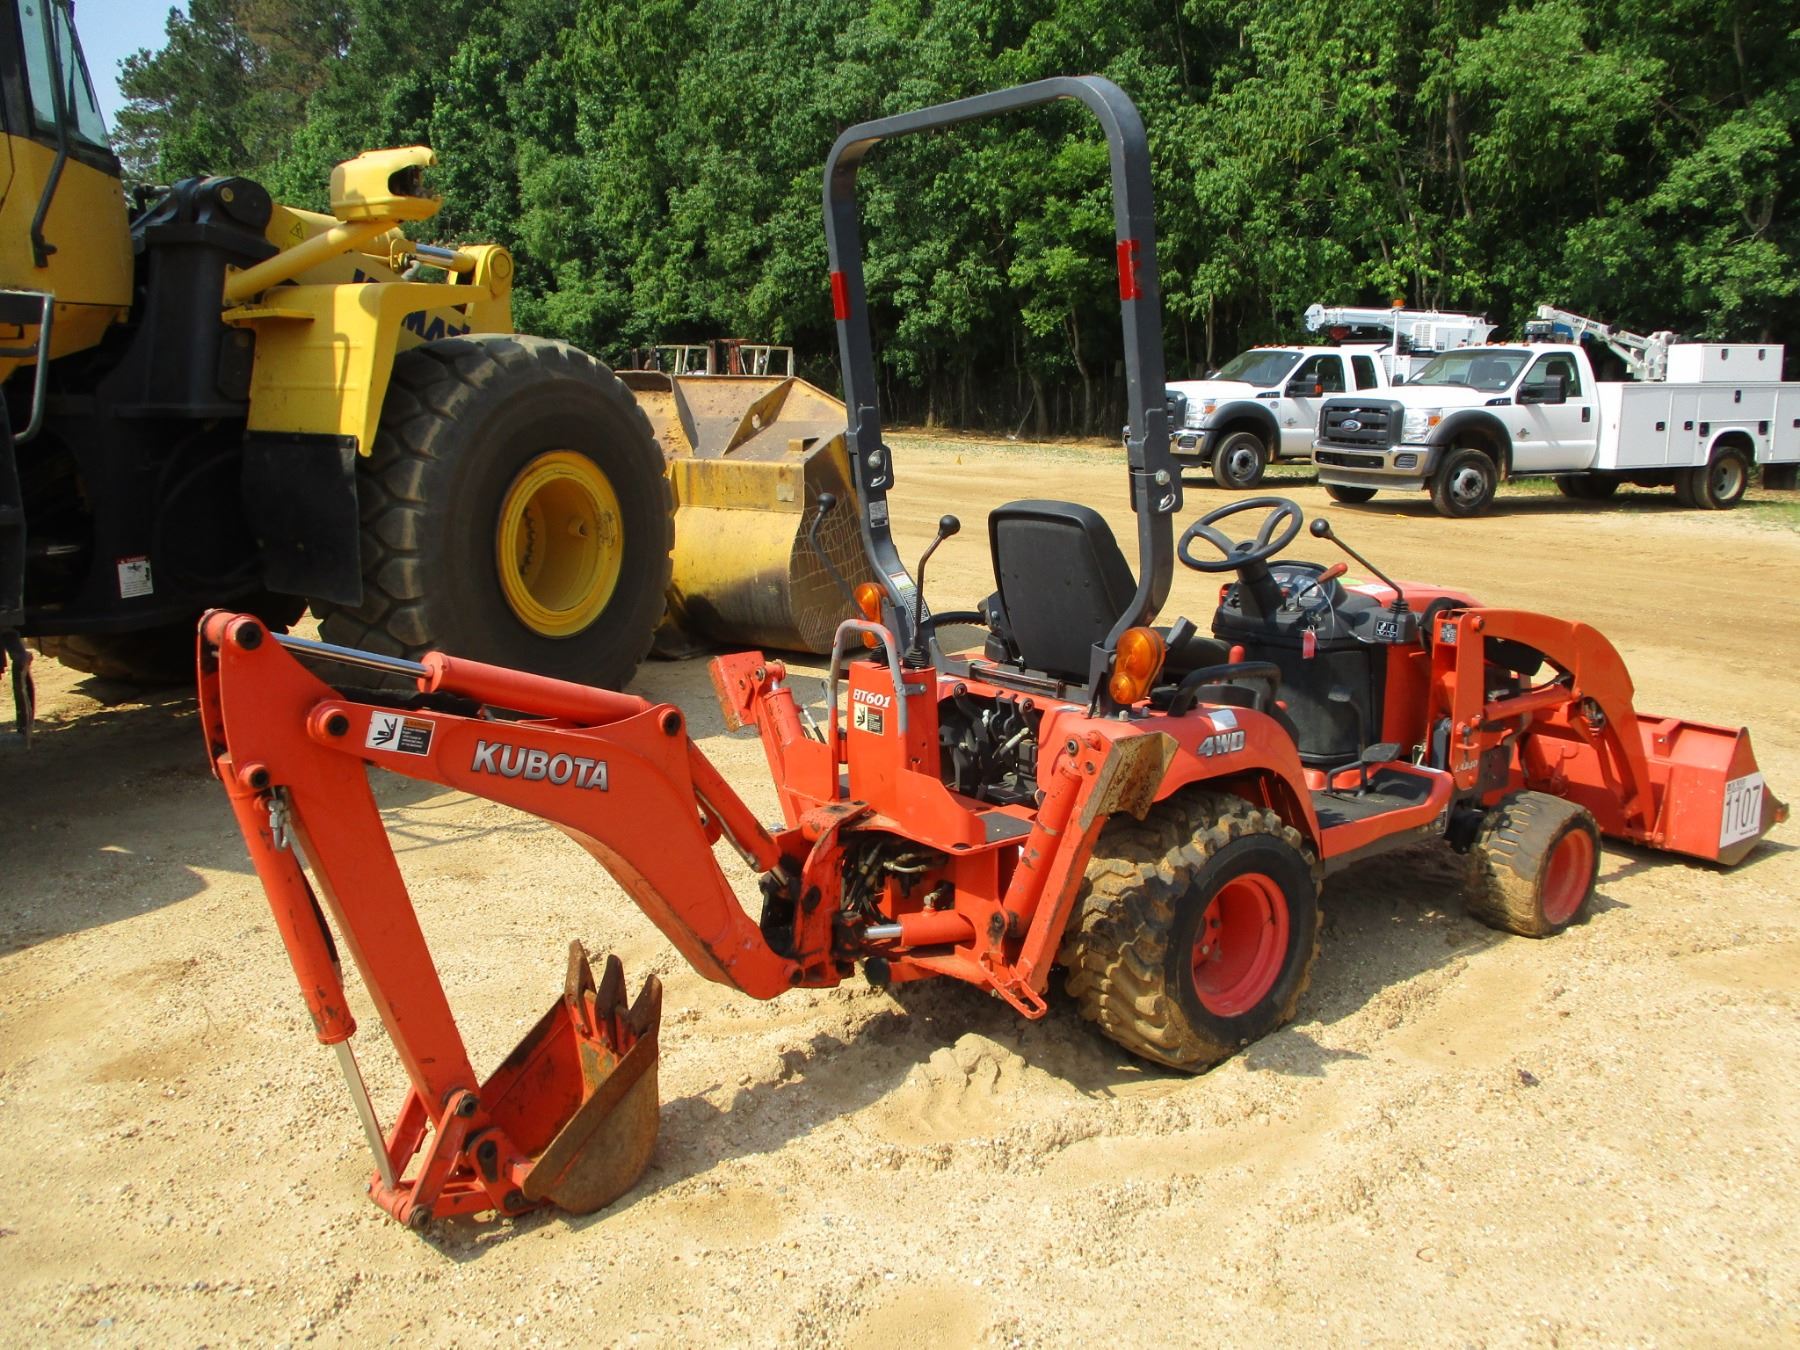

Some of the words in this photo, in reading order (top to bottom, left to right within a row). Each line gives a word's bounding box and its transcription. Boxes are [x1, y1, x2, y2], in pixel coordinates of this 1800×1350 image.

[853, 688, 891, 708] BT601
[1197, 730, 1245, 757] 4WD
[471, 739, 609, 791] KUBOTA
[1726, 784, 1761, 834] 1107
